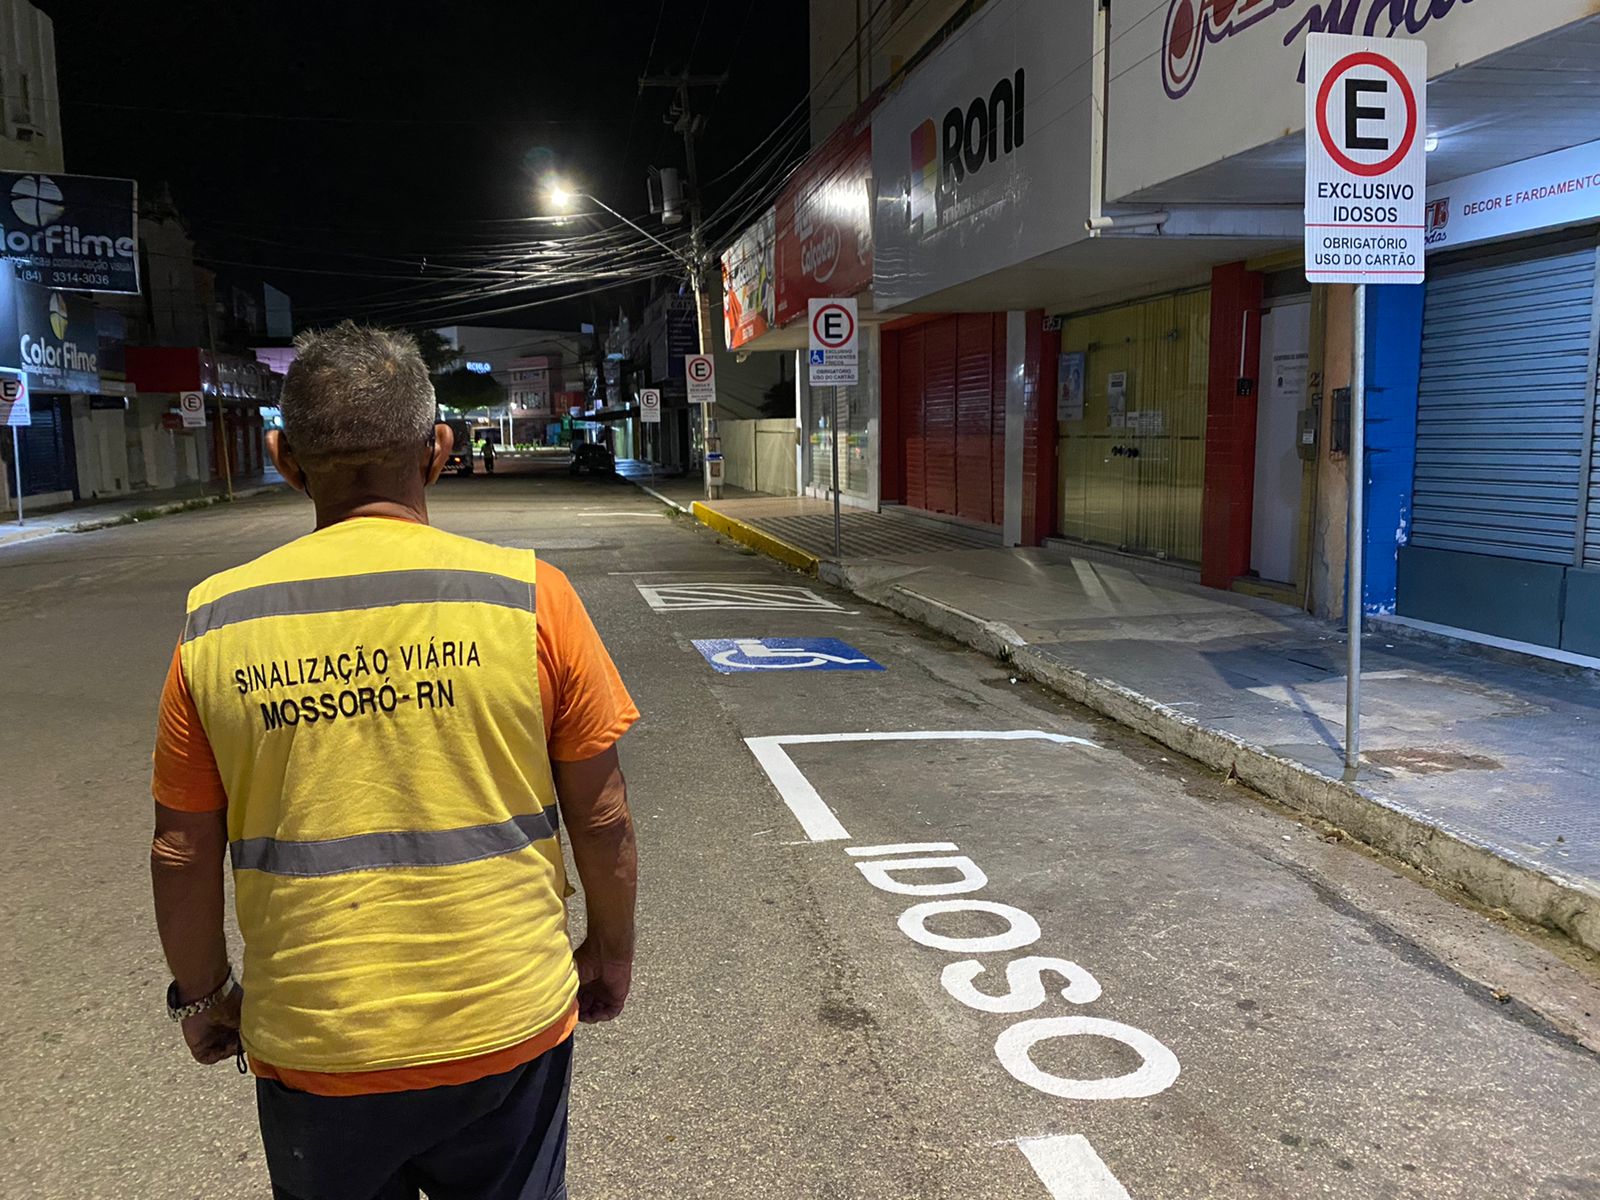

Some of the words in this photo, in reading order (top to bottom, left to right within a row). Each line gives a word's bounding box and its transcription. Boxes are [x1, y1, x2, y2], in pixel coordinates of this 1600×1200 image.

[1345, 78, 1389, 150] E
[1317, 182, 1414, 200] EXCLUSIVO
[1463, 199, 1502, 216] DECOR
[1505, 194, 1513, 206] E
[1333, 206, 1398, 222] IDOSOS
[1323, 235, 1408, 250] OBRIGATÓRIO
[1315, 254, 1341, 266] USO
[1344, 254, 1362, 266] DO
[1365, 251, 1416, 266] CARTÃO
[21, 270, 42, 283] (84)
[824, 313, 843, 339] E
[20, 334, 62, 366] Color
[63, 341, 97, 372] Filme
[695, 362, 706, 377] E
[4, 381, 19, 396] E
[187, 397, 197, 408] E
[646, 394, 654, 404] E
[235, 645, 388, 695] SINALIZAÇÃO
[400, 636, 480, 671] VIÁRIA
[260, 677, 454, 731] MOSSORÓ-RN
[844, 842, 1181, 1100] IDOSO
